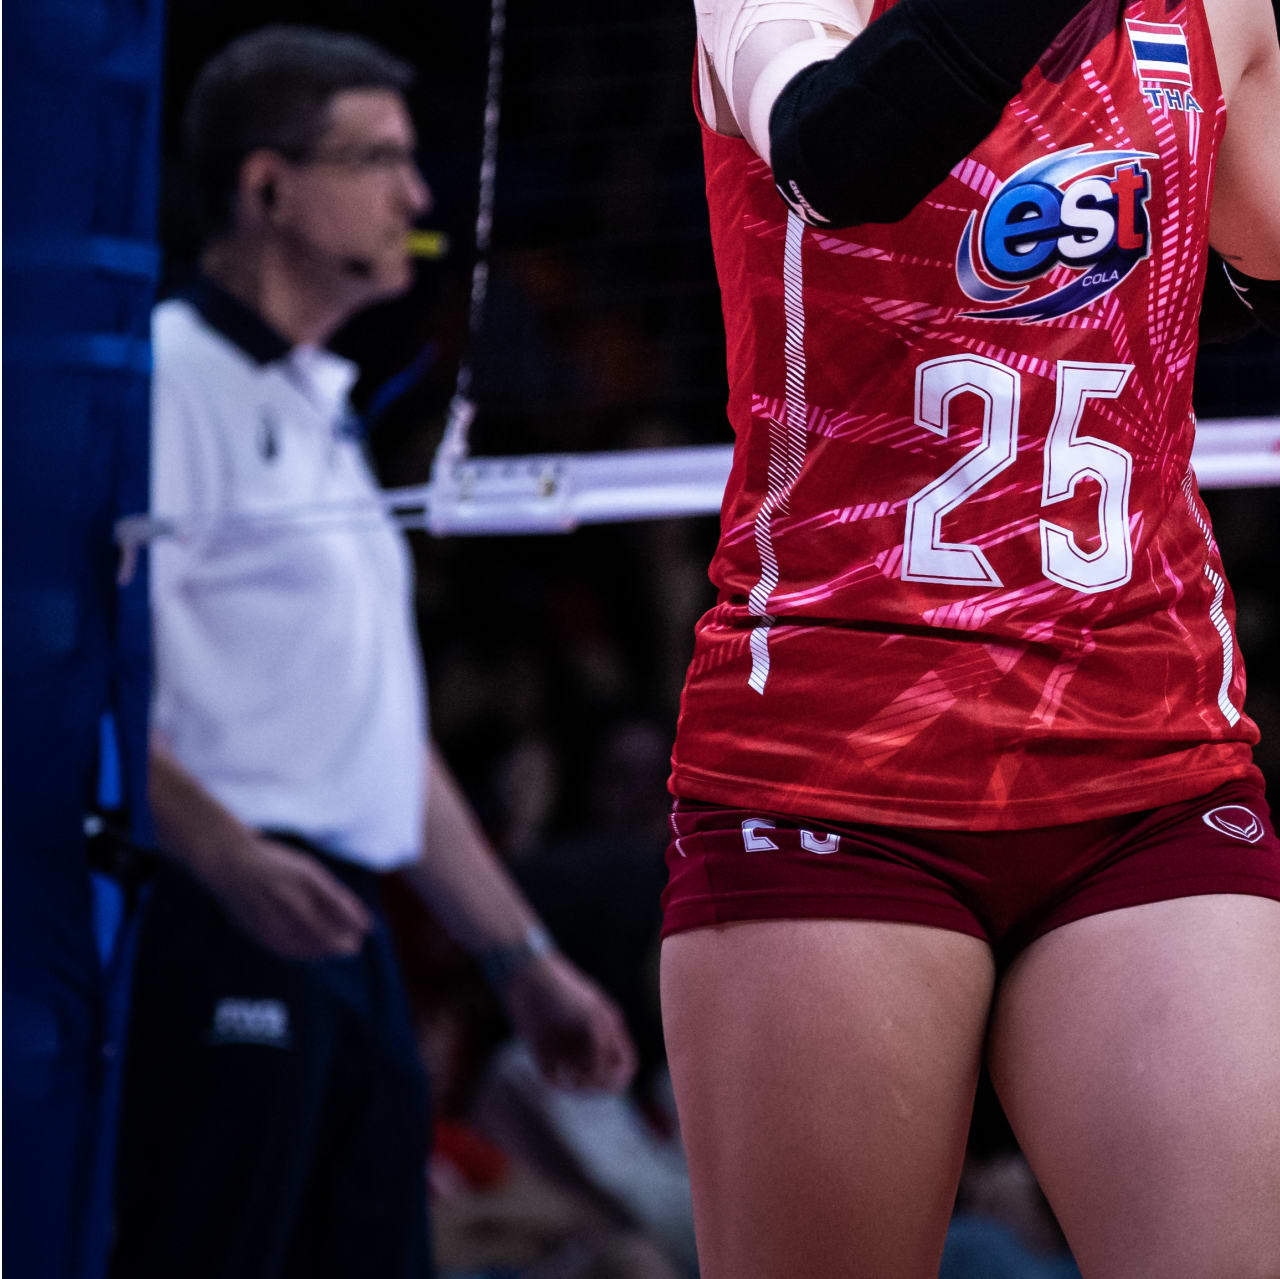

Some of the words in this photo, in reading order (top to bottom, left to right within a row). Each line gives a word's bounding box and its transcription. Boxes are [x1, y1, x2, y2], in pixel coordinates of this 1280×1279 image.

[1142, 87, 1205, 113] THA
[984, 165, 1147, 274] est
[1082, 269, 1119, 287] COLA
[900, 353, 1136, 595] 25
